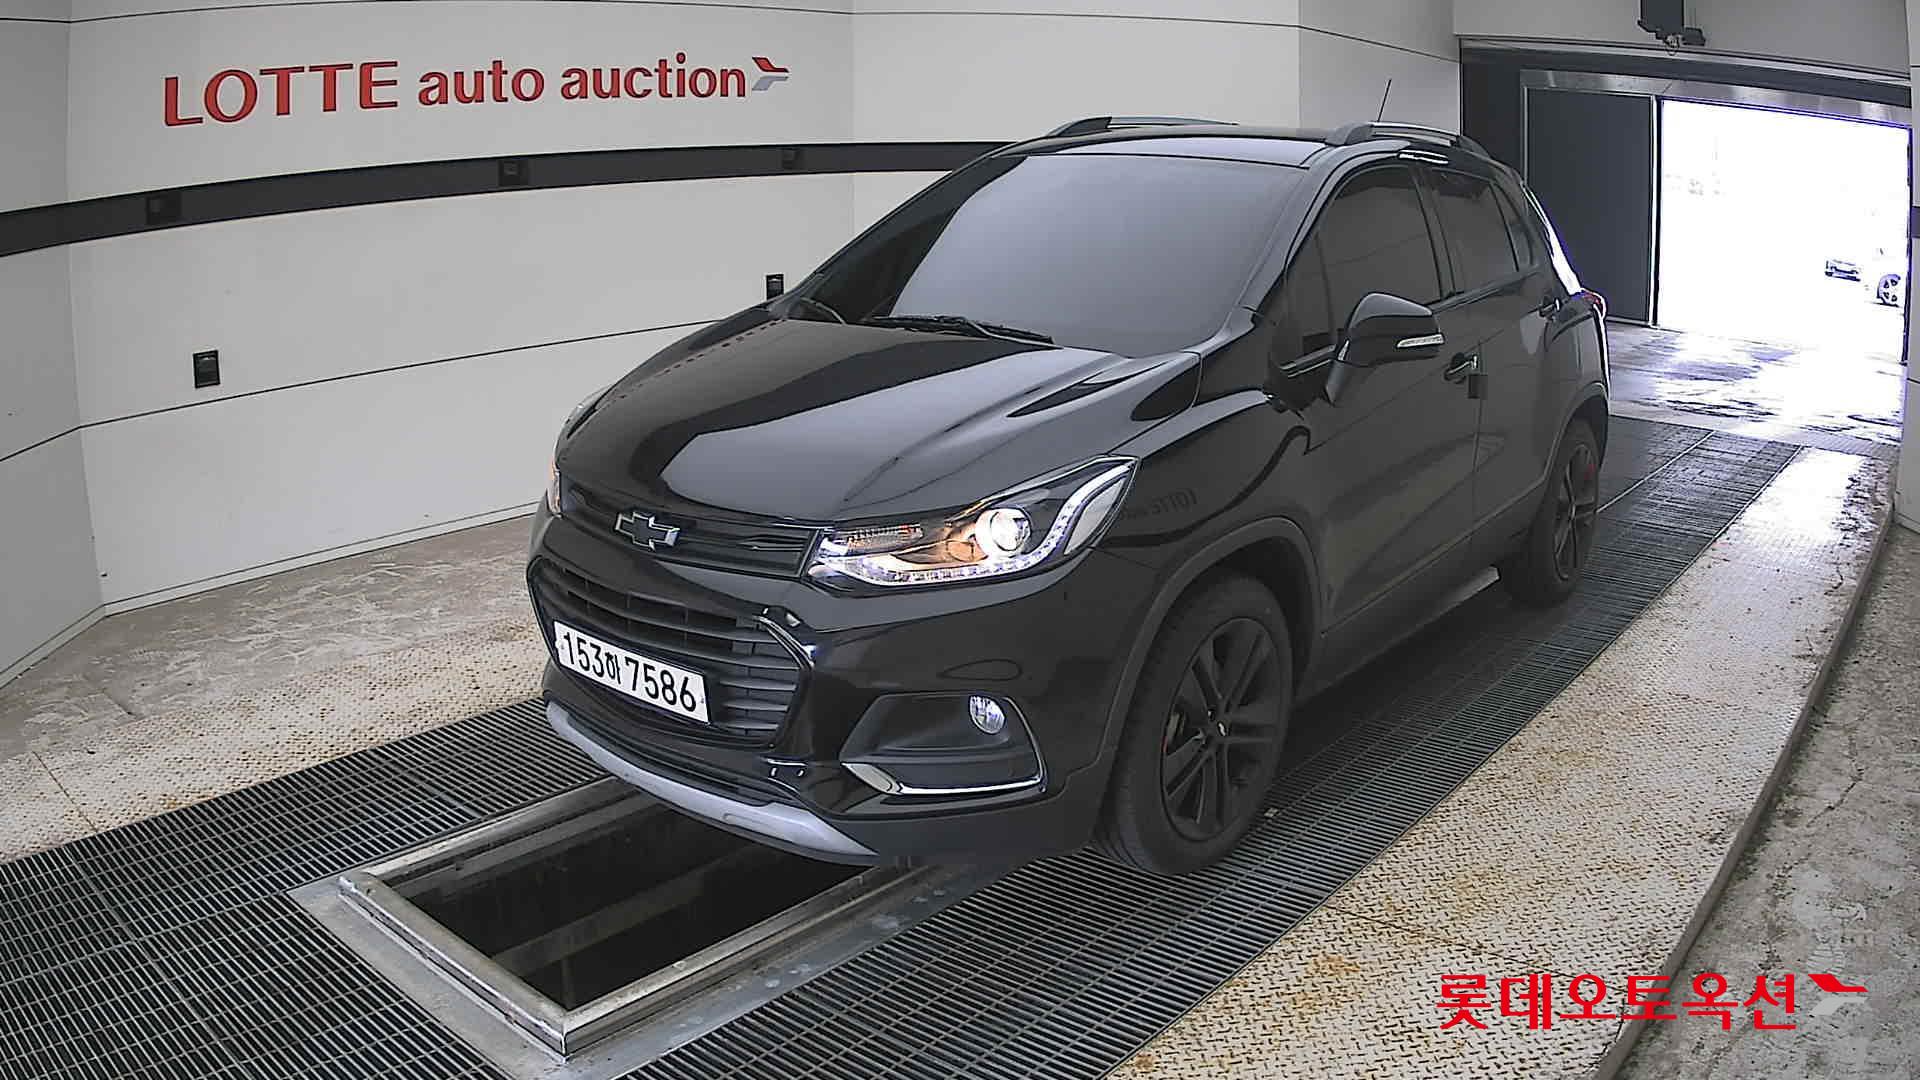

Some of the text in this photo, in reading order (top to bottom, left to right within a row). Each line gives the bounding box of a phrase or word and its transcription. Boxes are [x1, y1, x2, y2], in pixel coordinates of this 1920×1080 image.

[164, 53, 747, 126] LOTTE auto auction
